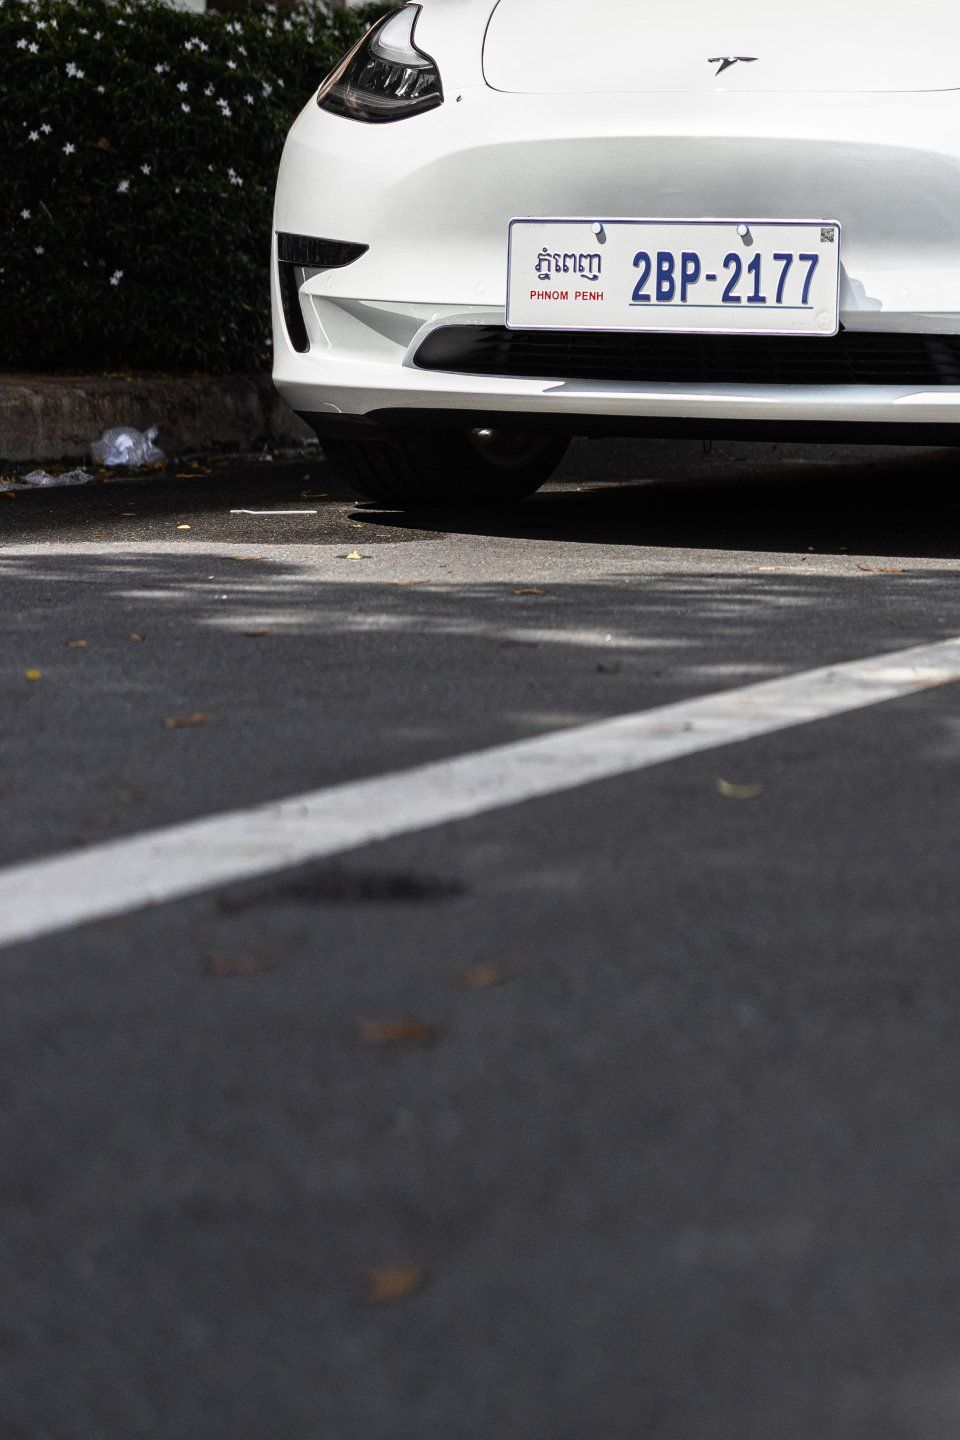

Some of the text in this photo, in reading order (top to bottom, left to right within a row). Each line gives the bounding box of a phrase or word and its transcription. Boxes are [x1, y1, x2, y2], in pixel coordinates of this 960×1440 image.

[535, 247, 602, 281] ភ្នំពេញ
[631, 251, 819, 304] 2BP-2177
[530, 290, 604, 301] PHNOM PENH
